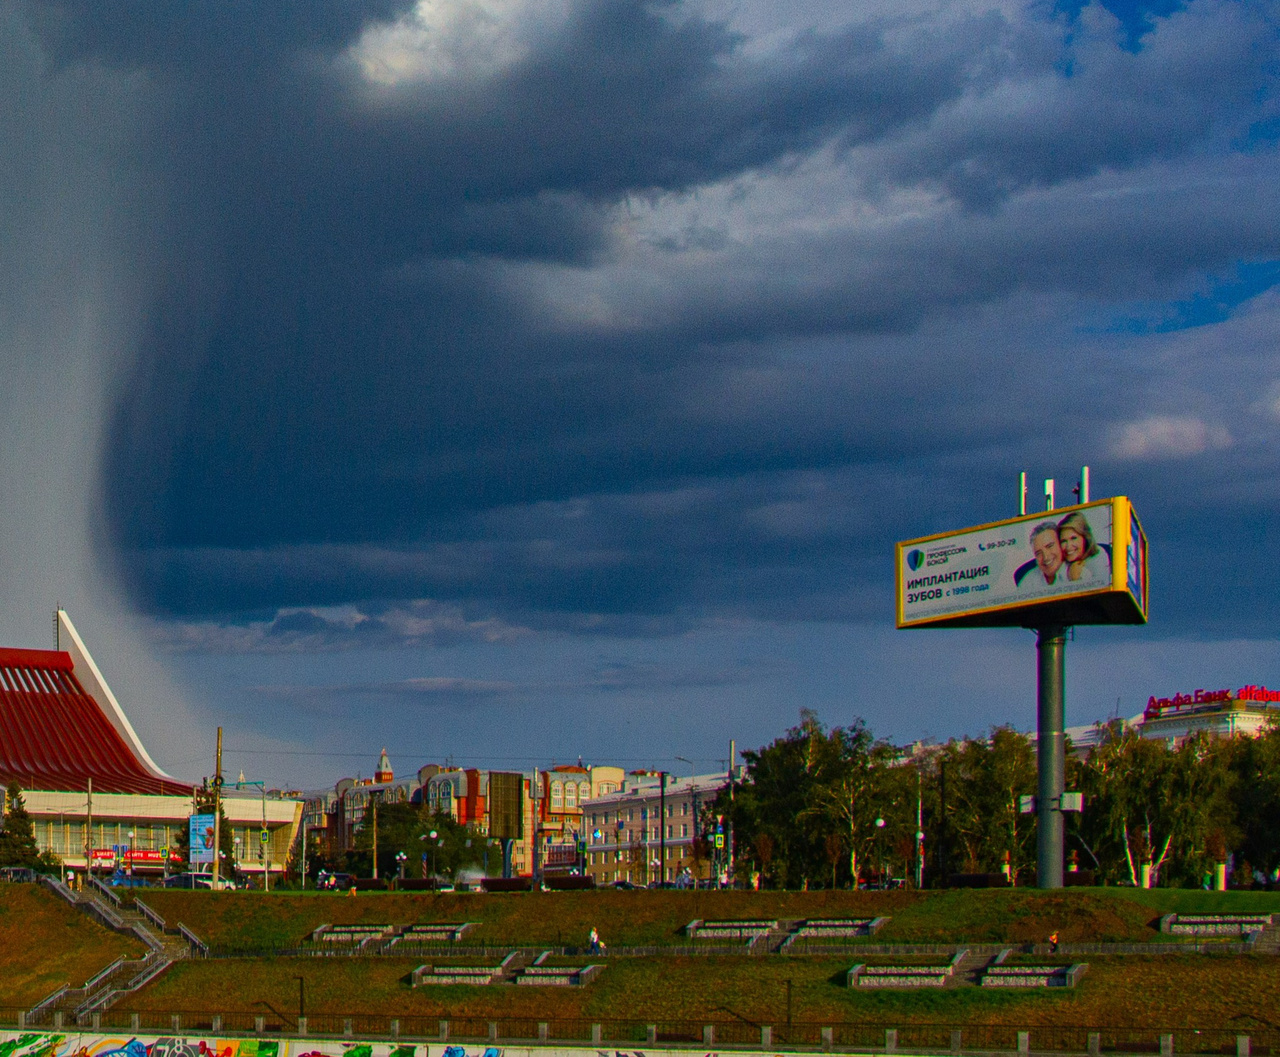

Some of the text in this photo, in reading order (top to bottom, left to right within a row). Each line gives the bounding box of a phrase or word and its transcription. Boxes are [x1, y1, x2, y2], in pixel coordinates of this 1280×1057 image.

[907, 565, 989, 590] ИМПЛАНТАЦИЯ
[907, 588, 942, 604] ЗУБОВ
[952, 585, 970, 596] 1998
[971, 584, 990, 593] года
[1194, 689, 1230, 702] Банк
